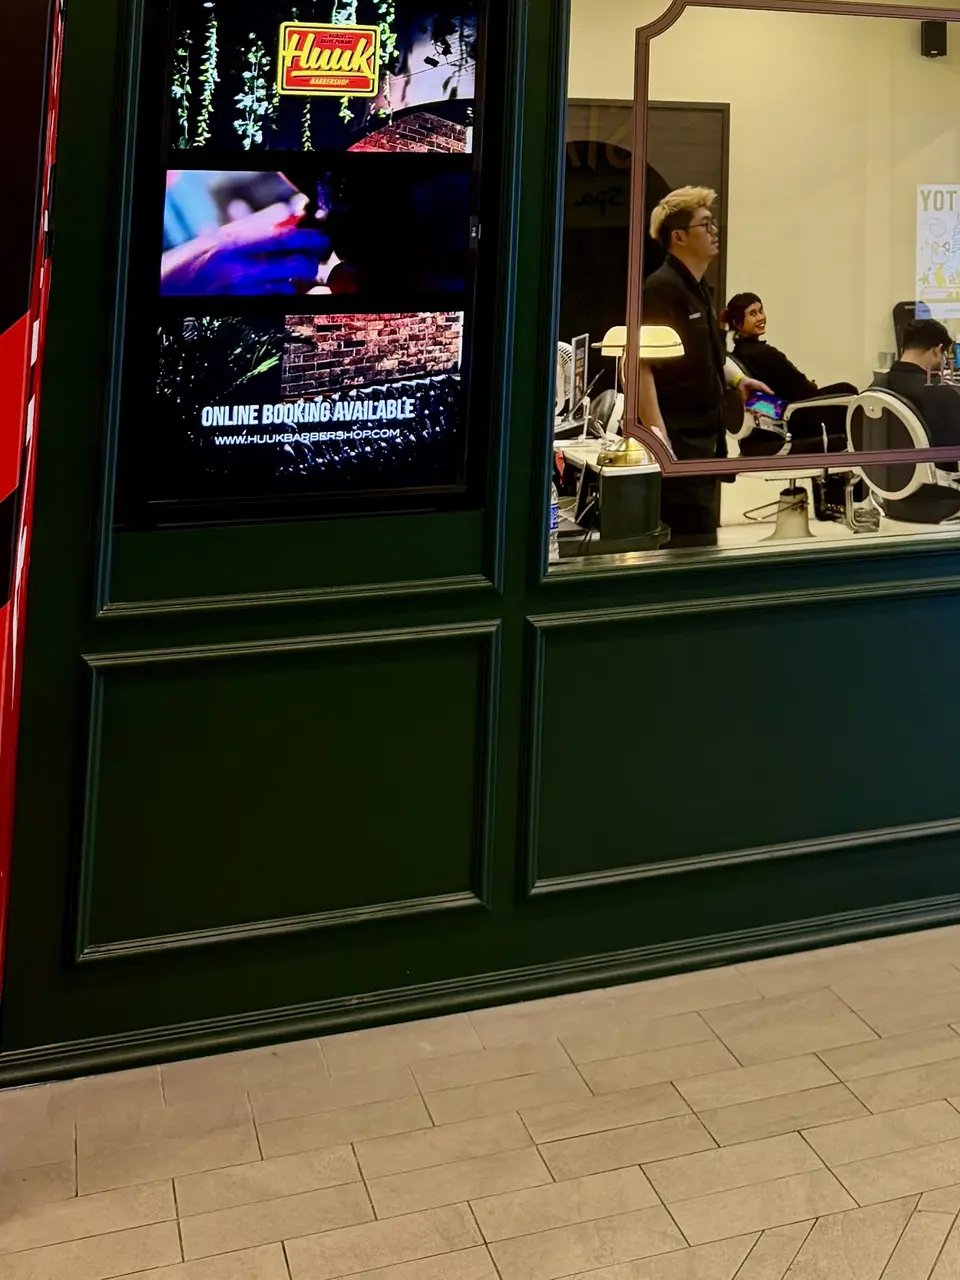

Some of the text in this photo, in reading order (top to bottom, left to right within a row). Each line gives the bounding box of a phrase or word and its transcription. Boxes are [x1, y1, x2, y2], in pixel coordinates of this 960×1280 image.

[281, 33, 376, 79] Huuk
[201, 398, 416, 427] ONLINE BOOKING AVAILABLE
[214, 428, 400, 445] WWW.HUUKBARBERSHOP.COM
